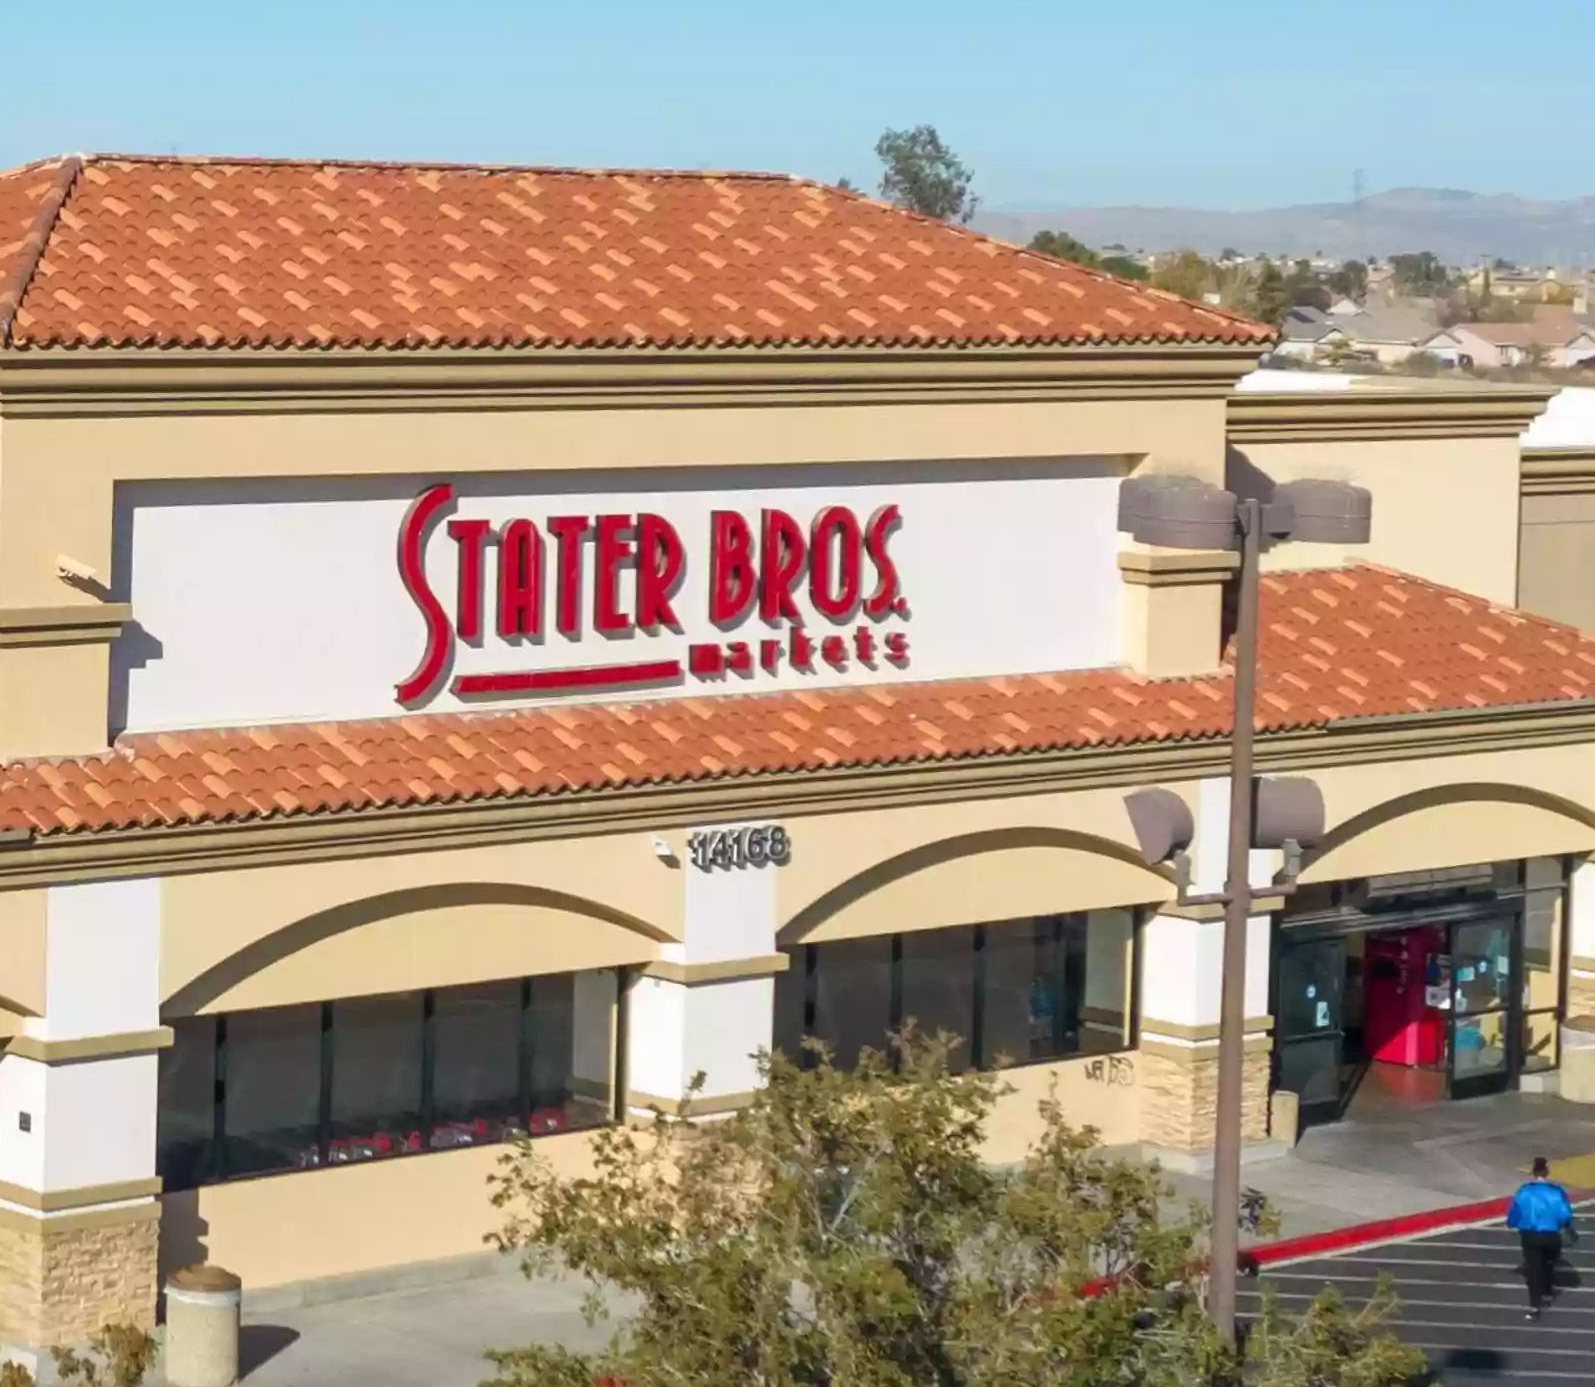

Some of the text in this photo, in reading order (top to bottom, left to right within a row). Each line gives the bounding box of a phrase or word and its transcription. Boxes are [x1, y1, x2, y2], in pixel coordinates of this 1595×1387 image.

[395, 483, 686, 706] STATER
[689, 624, 909, 680] markets
[689, 824, 791, 870] 14168
